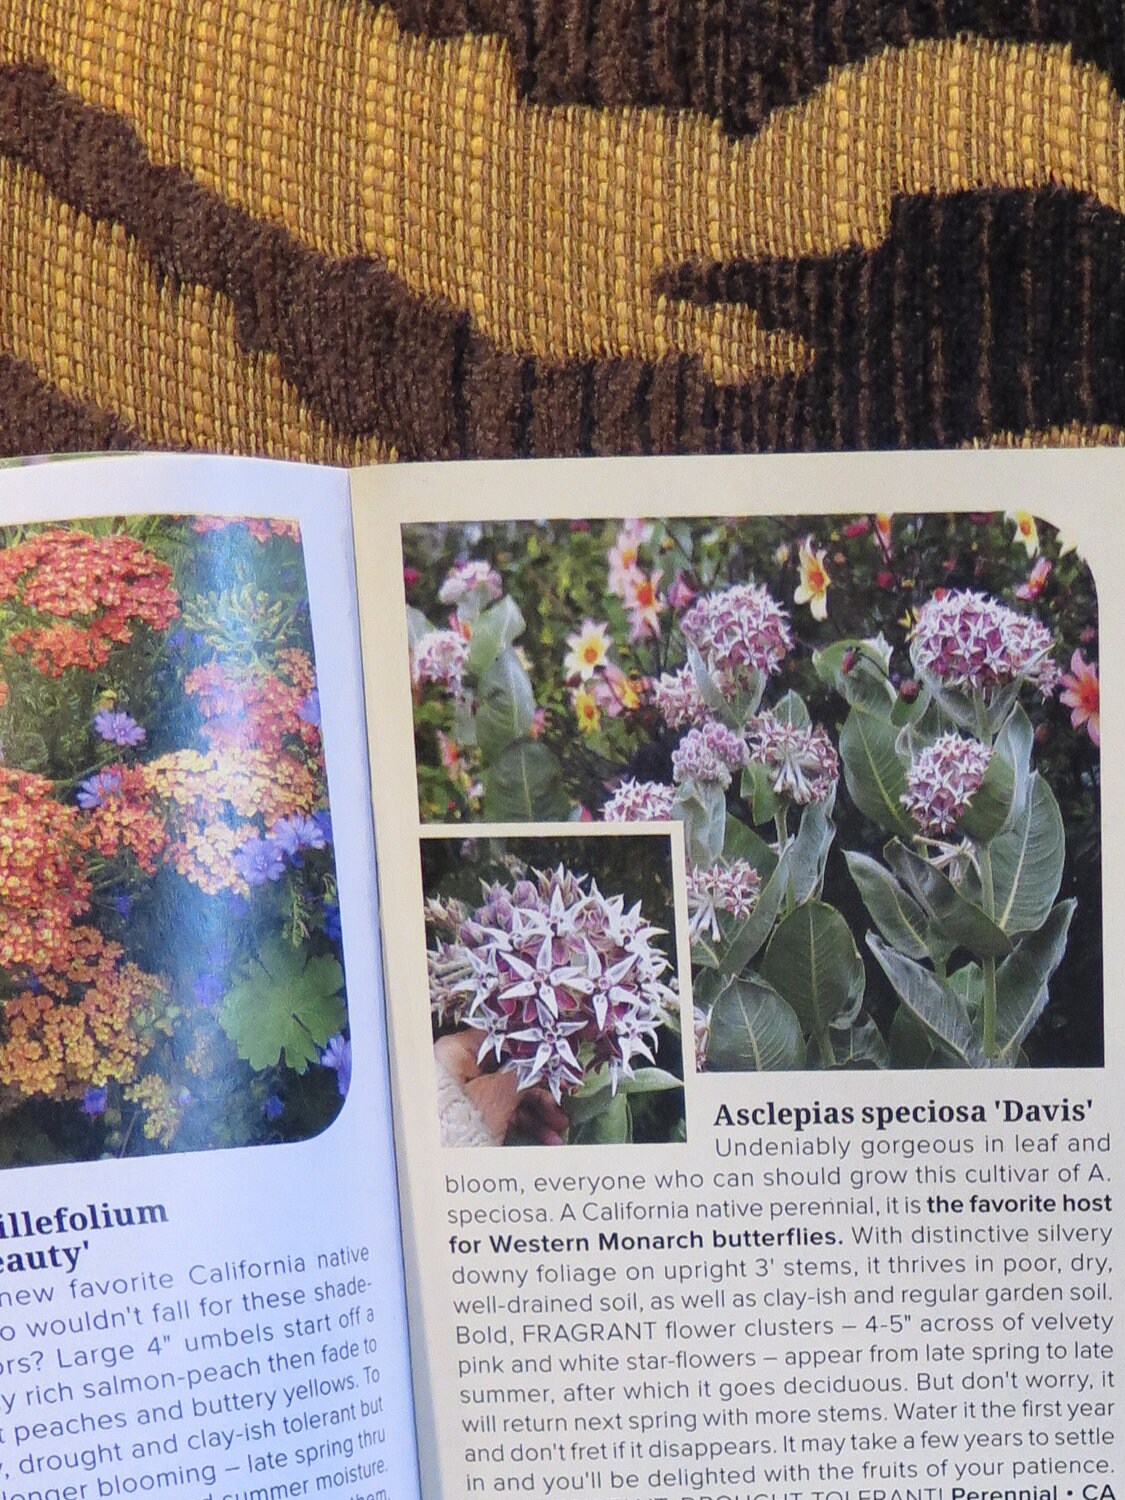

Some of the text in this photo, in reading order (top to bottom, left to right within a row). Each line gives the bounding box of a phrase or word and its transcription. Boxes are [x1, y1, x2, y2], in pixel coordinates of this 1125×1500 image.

[713, 1098, 1092, 1132] Asclepias speciosa 'Davis'
[445, 1163, 1111, 1195] bloom, everyone who can should grow this cultivar of A.
[448, 1223, 1113, 1254] for Western Monarch butterflies. With distinctive silvery
[0, 1240, 88, 1274] auty'
